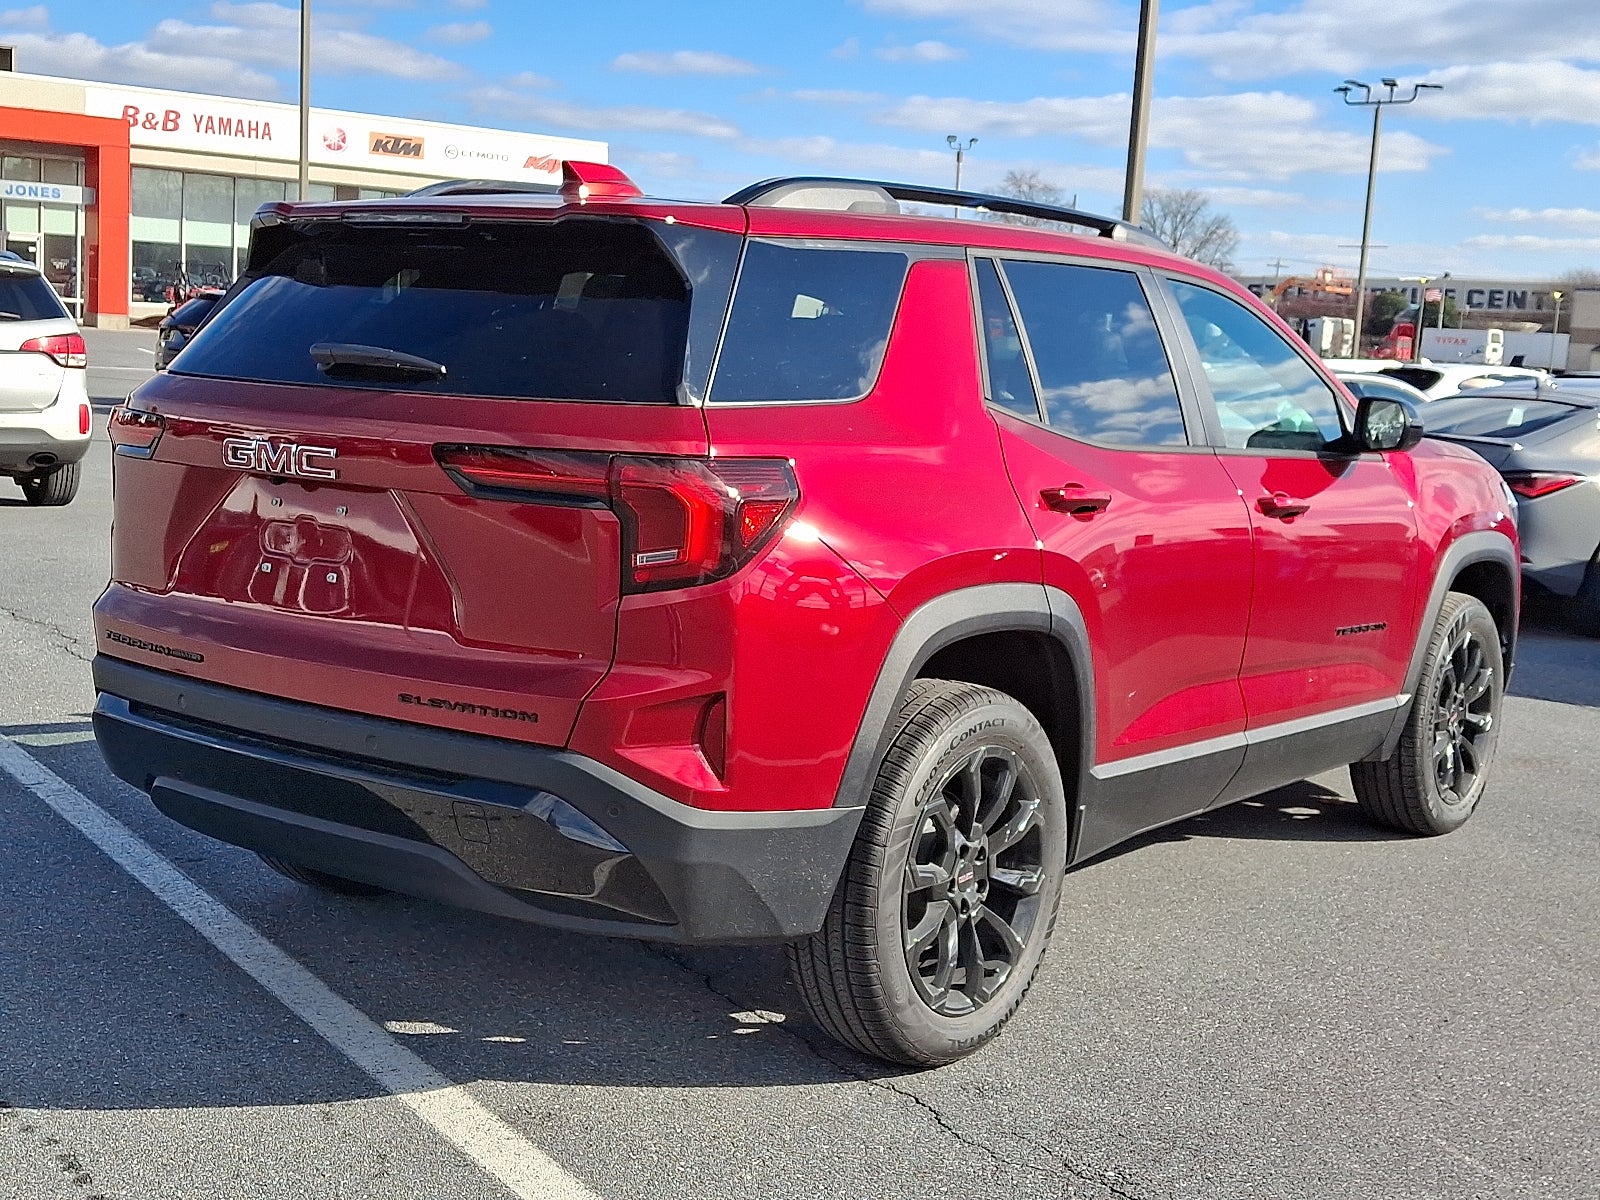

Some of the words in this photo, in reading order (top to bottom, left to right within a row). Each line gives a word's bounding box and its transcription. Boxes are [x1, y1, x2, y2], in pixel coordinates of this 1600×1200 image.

[122, 105, 181, 132] B&B
[193, 113, 272, 141] YAMAHA
[372, 136, 422, 156] KTM
[5, 184, 61, 199] JONES
[223, 437, 338, 480] GMC
[398, 693, 539, 723] ELEVATION
